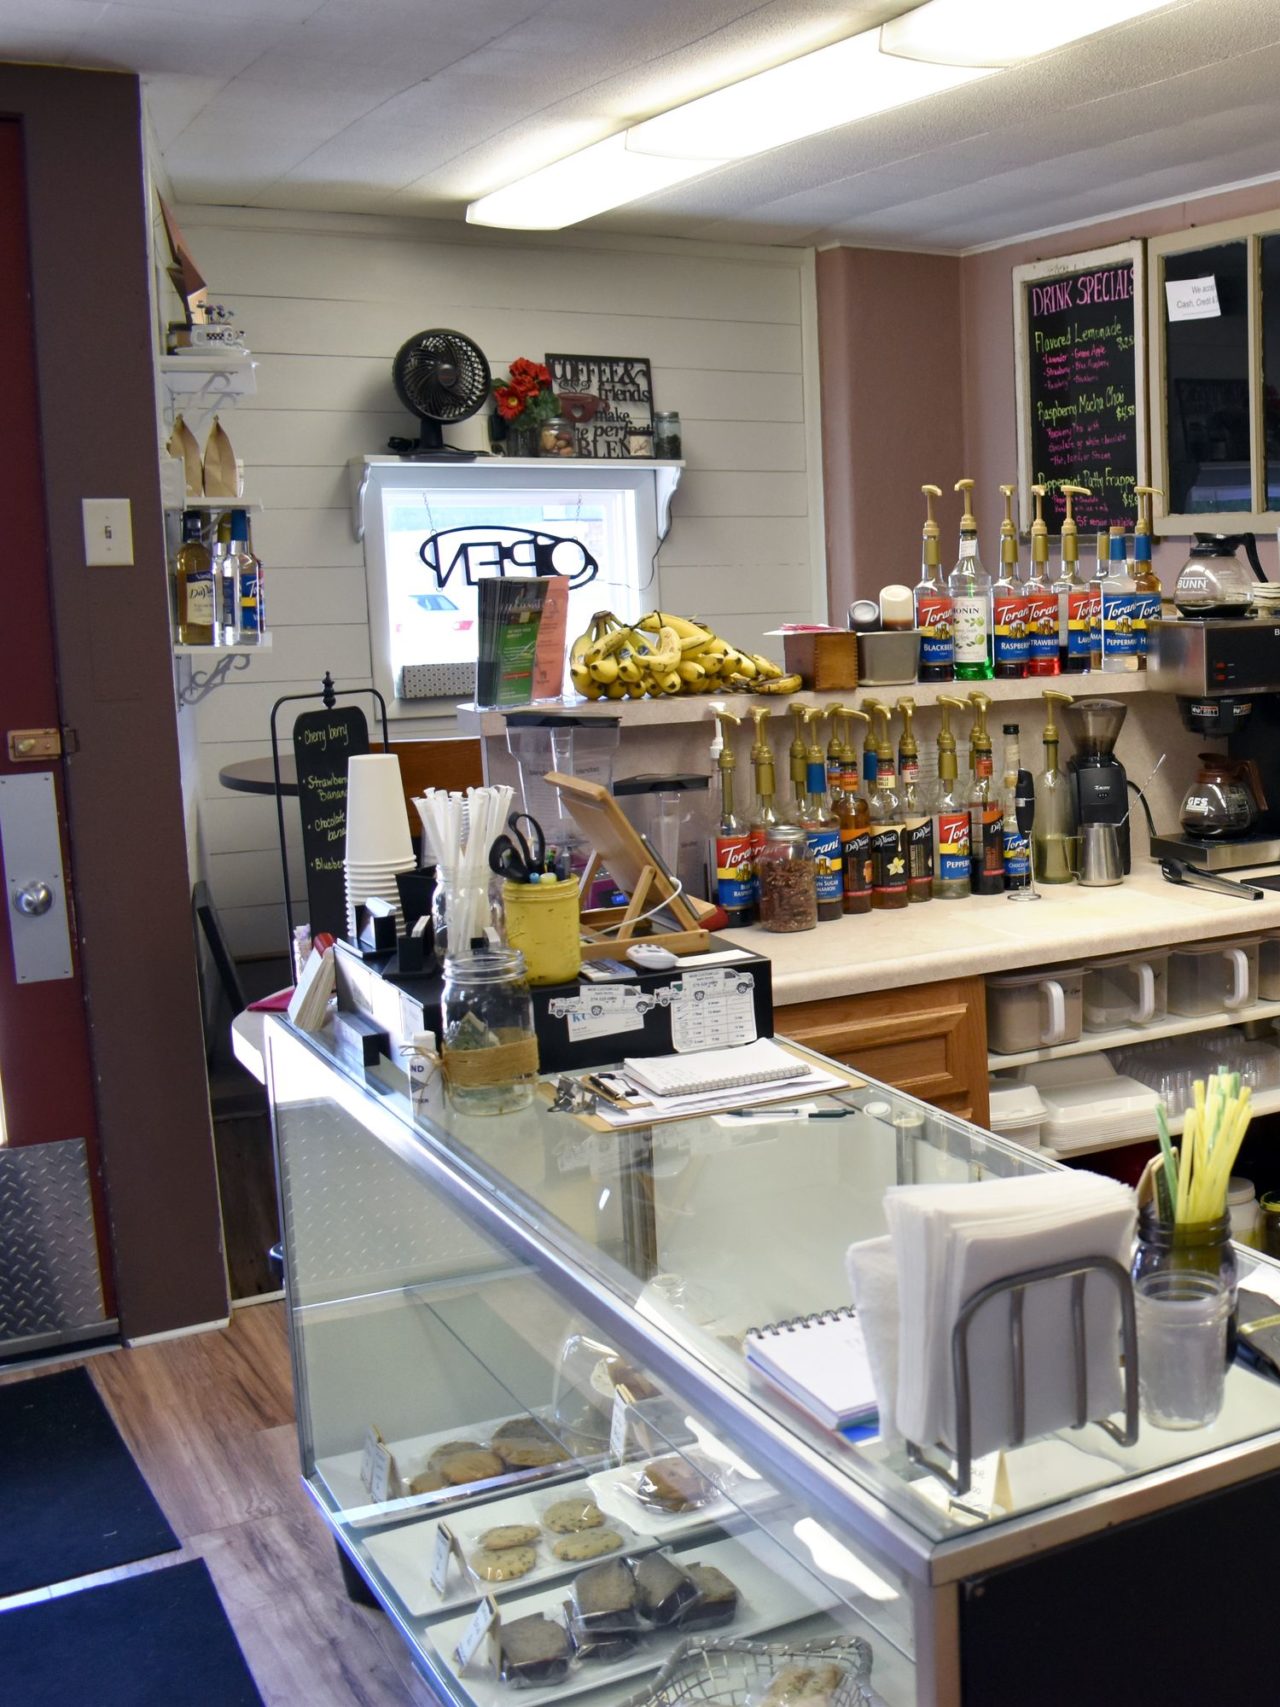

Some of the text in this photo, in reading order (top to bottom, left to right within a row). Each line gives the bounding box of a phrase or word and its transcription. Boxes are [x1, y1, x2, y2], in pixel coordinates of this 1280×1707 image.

[1032, 280, 1073, 317] DRINK
[1035, 314, 1122, 353] Flavored Lemonade
[599, 383, 650, 402] friends
[595, 407, 630, 422] make
[1037, 400, 1077, 427] Raspberry
[1105, 467, 1137, 494] Frappe
[1177, 579, 1208, 589] BUNN
[304, 723, 349, 750] Cherry berry
[314, 810, 346, 831] Chocolate
